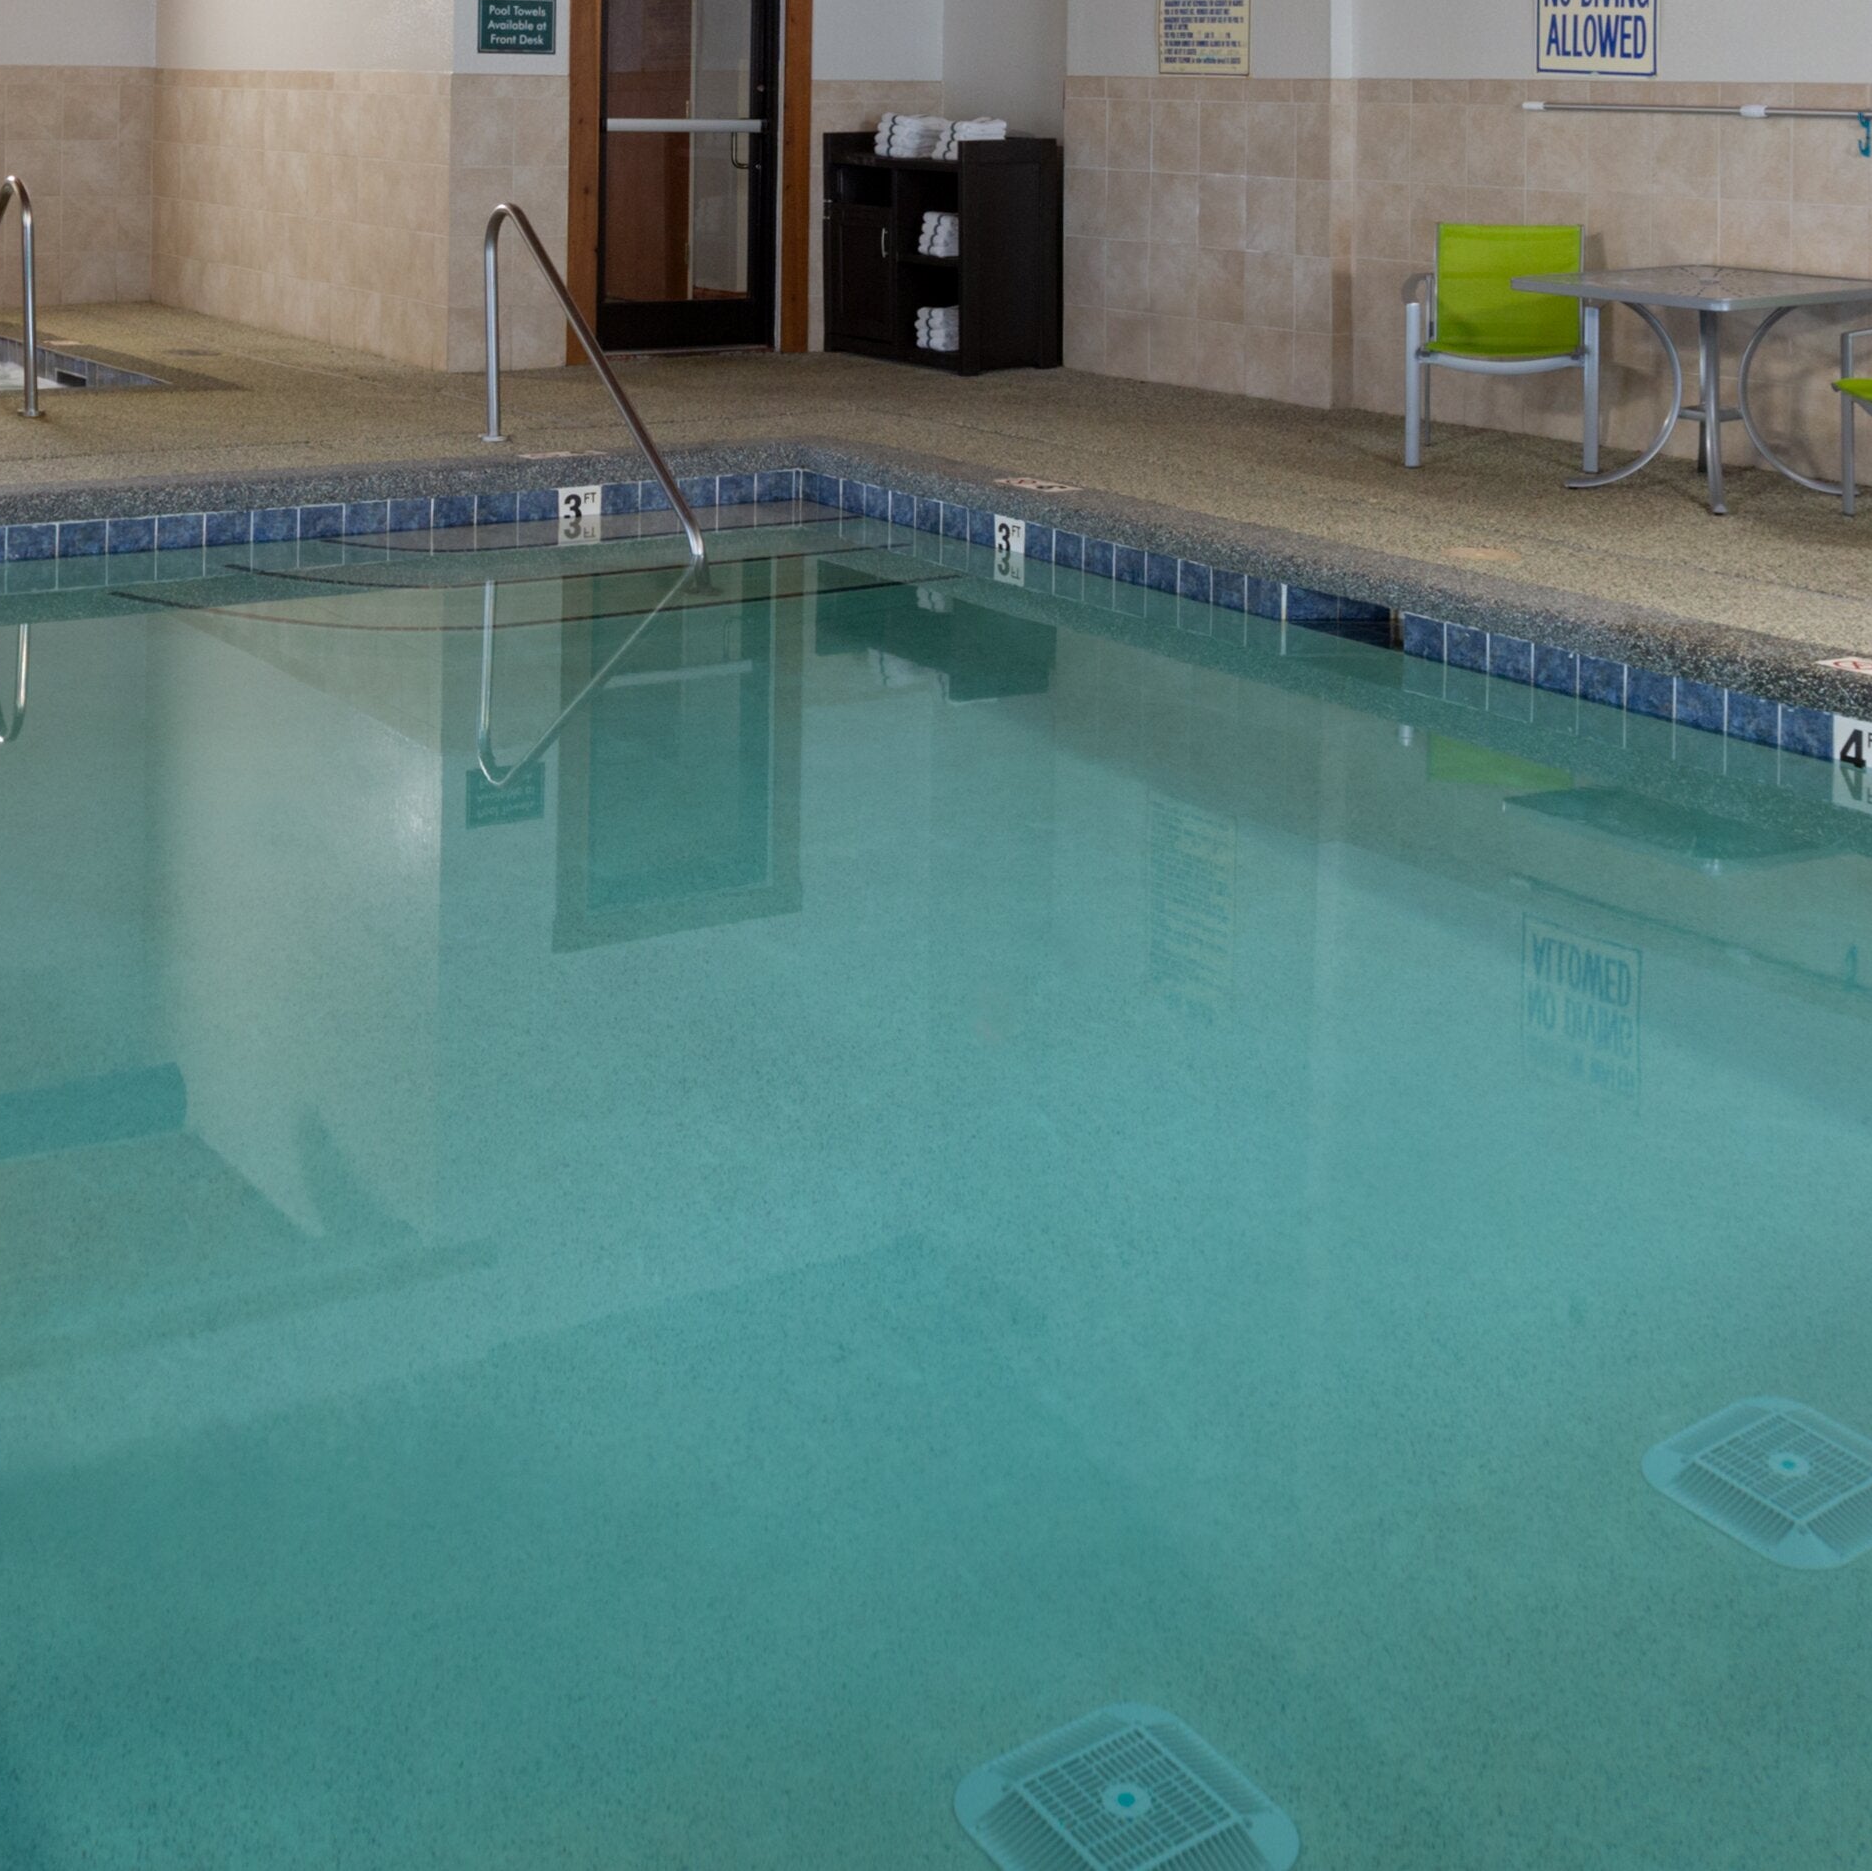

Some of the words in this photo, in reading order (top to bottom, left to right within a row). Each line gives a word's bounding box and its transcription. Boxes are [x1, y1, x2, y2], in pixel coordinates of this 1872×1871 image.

[489, 5, 511, 16] Pool
[513, 5, 546, 17] Towels
[487, 20, 534, 31] Available
[536, 21, 547, 31] at
[1546, 14, 1647, 59] ALLOWED
[490, 34, 517, 45] Front
[519, 34, 544, 45] Desk
[564, 494, 582, 518] 3
[584, 492, 597, 504] FT
[998, 523, 1010, 551] 3
[1840, 728, 1866, 768] 4
